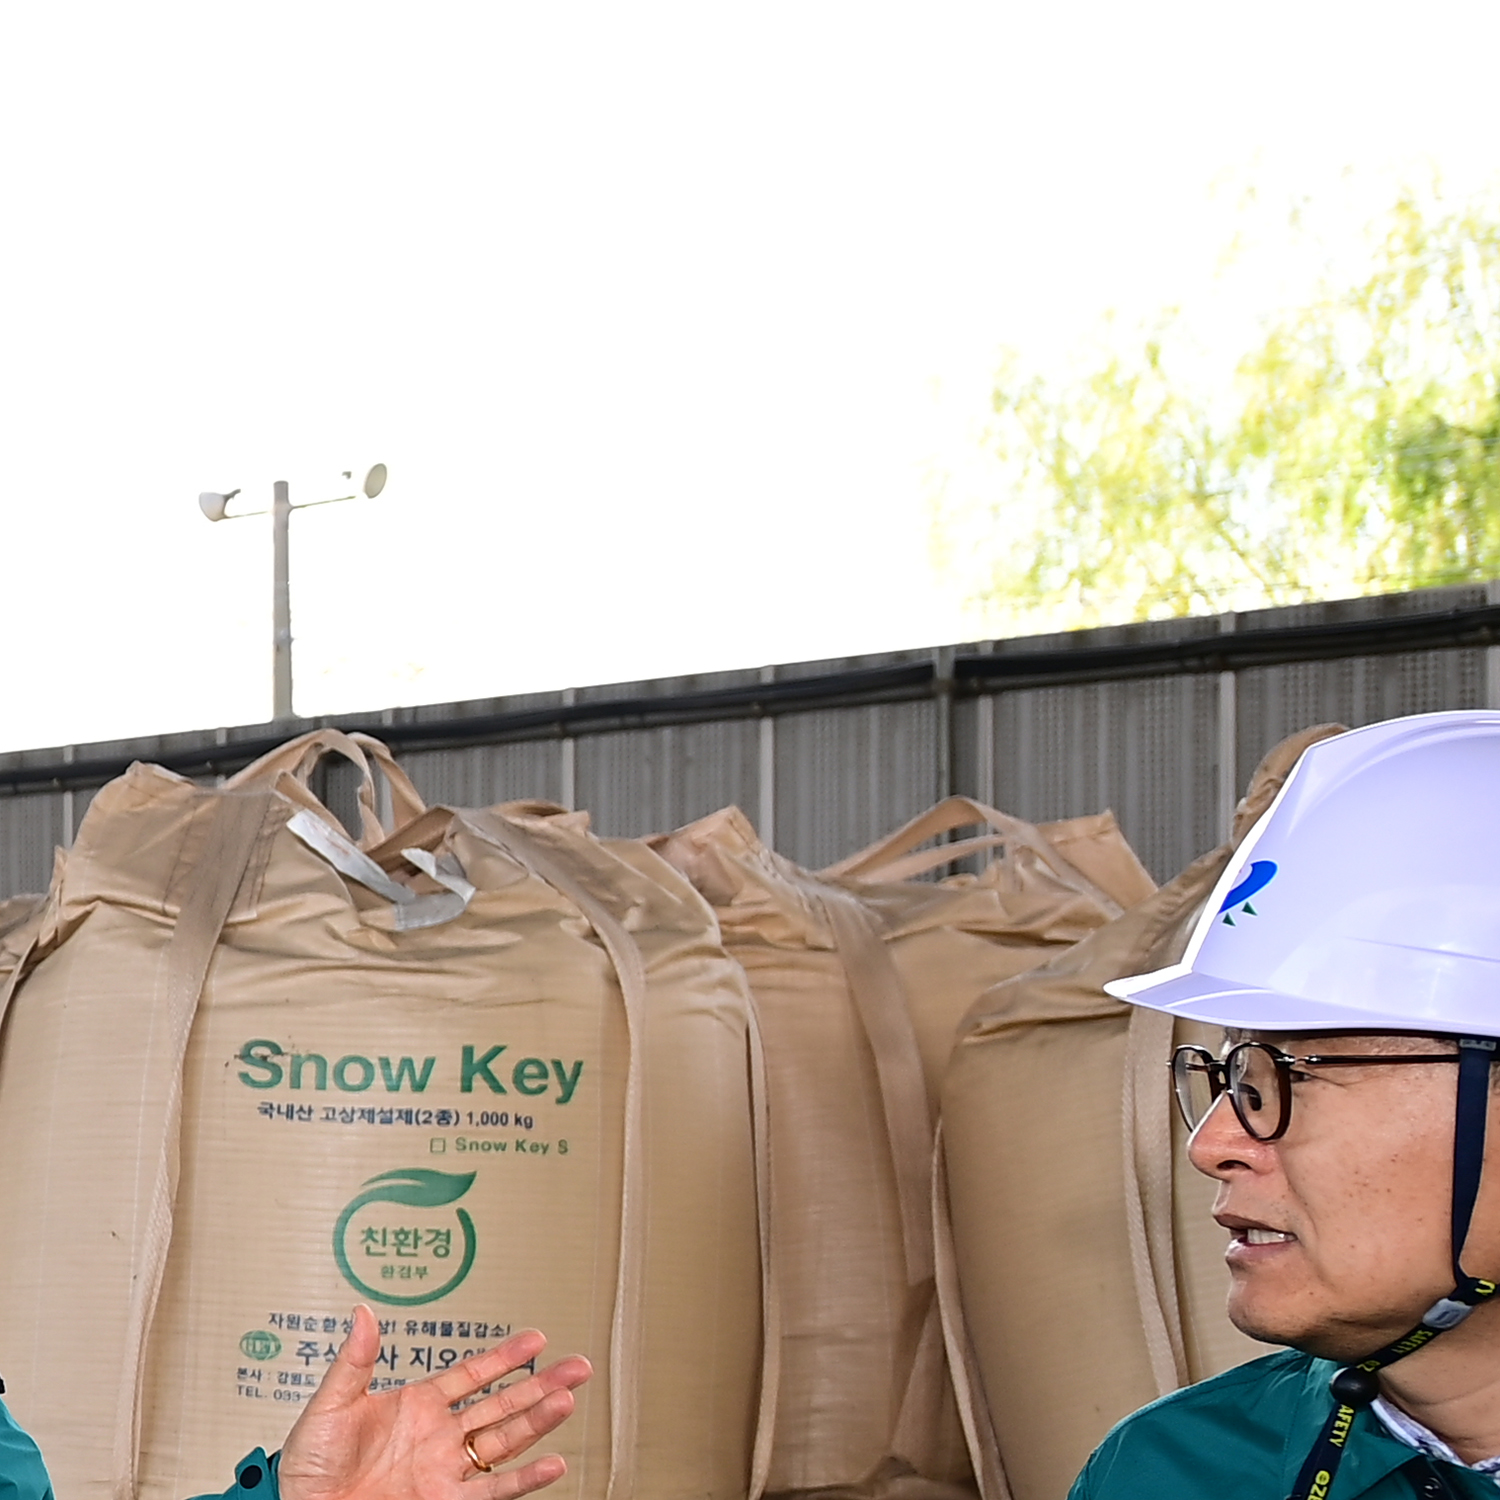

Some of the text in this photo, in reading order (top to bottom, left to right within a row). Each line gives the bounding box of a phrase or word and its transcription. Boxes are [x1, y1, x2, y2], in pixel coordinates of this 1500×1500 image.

[237, 1039, 584, 1105] Snow Key
[257, 1101, 314, 1122] 국내산
[466, 1111, 509, 1128] 1,000
[514, 1113, 534, 1130] kg
[455, 1136, 569, 1155] Snow Key S
[360, 1226, 451, 1259] 친환경
